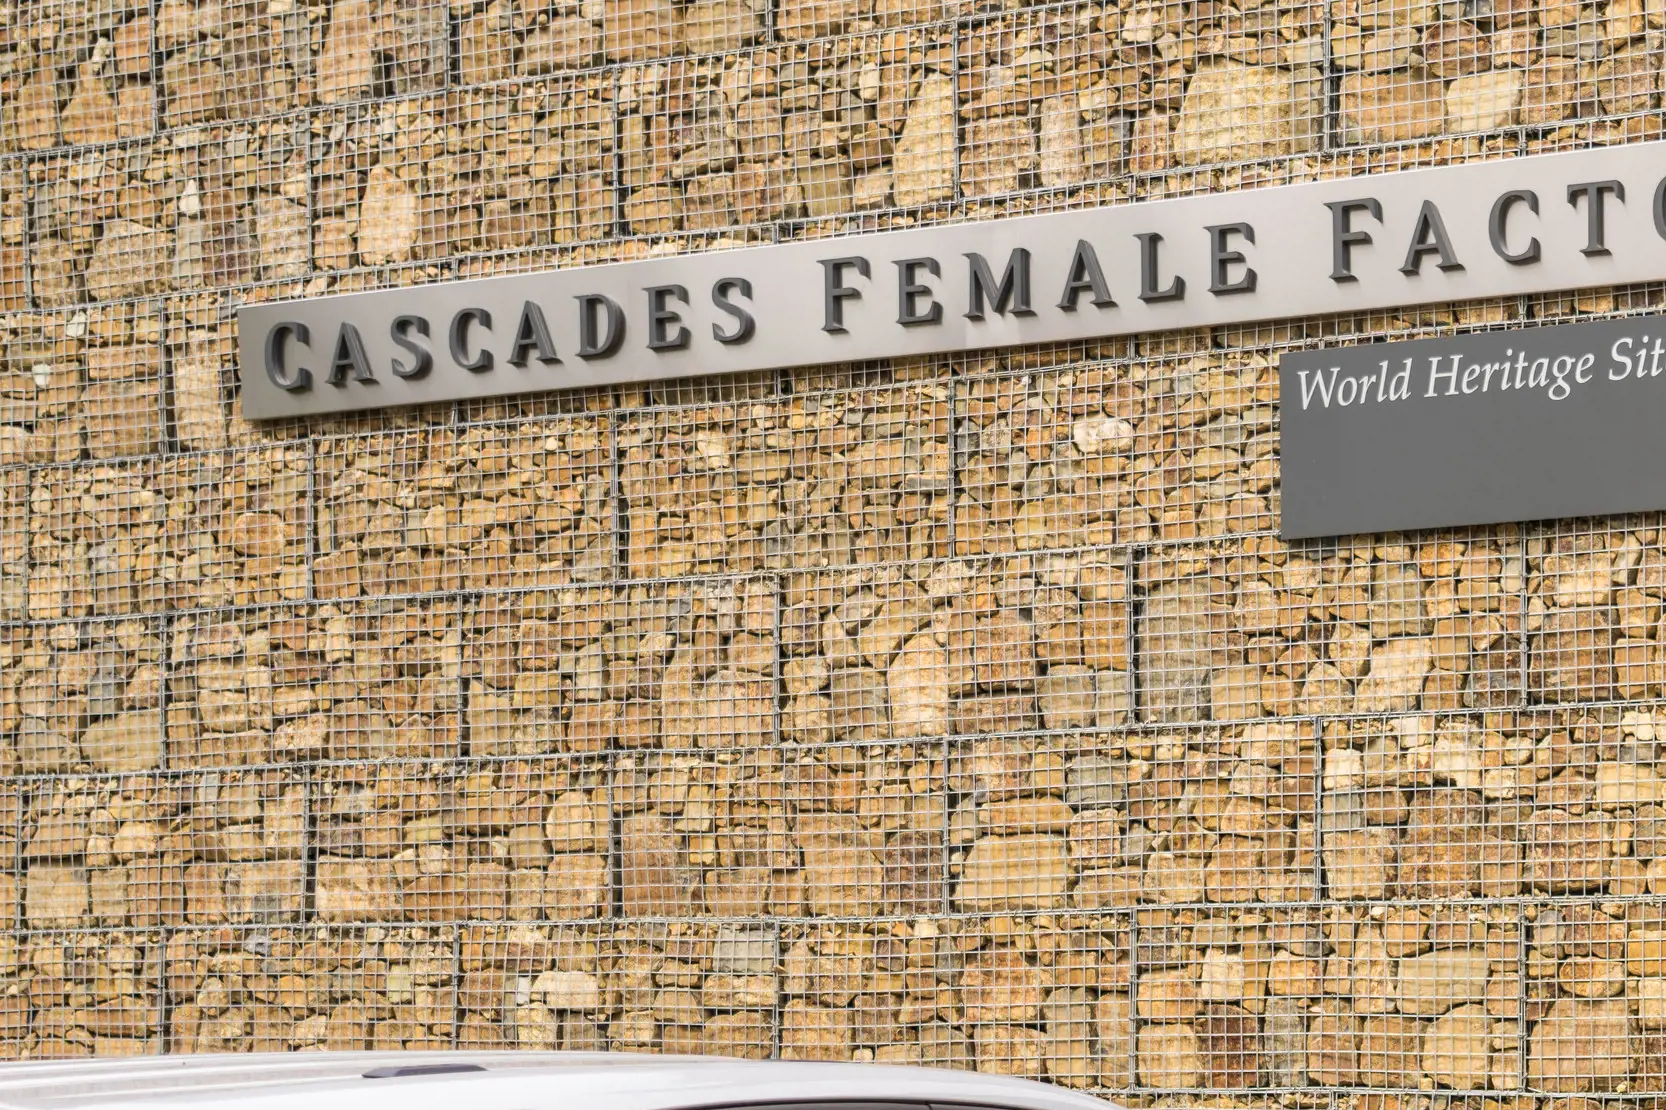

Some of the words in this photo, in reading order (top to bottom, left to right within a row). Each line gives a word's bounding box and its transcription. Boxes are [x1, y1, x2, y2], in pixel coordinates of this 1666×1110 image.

[264, 276, 756, 392] CASCADES
[817, 221, 1257, 335] FEMALE
[1297, 351, 1413, 411] World
[1424, 346, 1596, 402] Heritage
